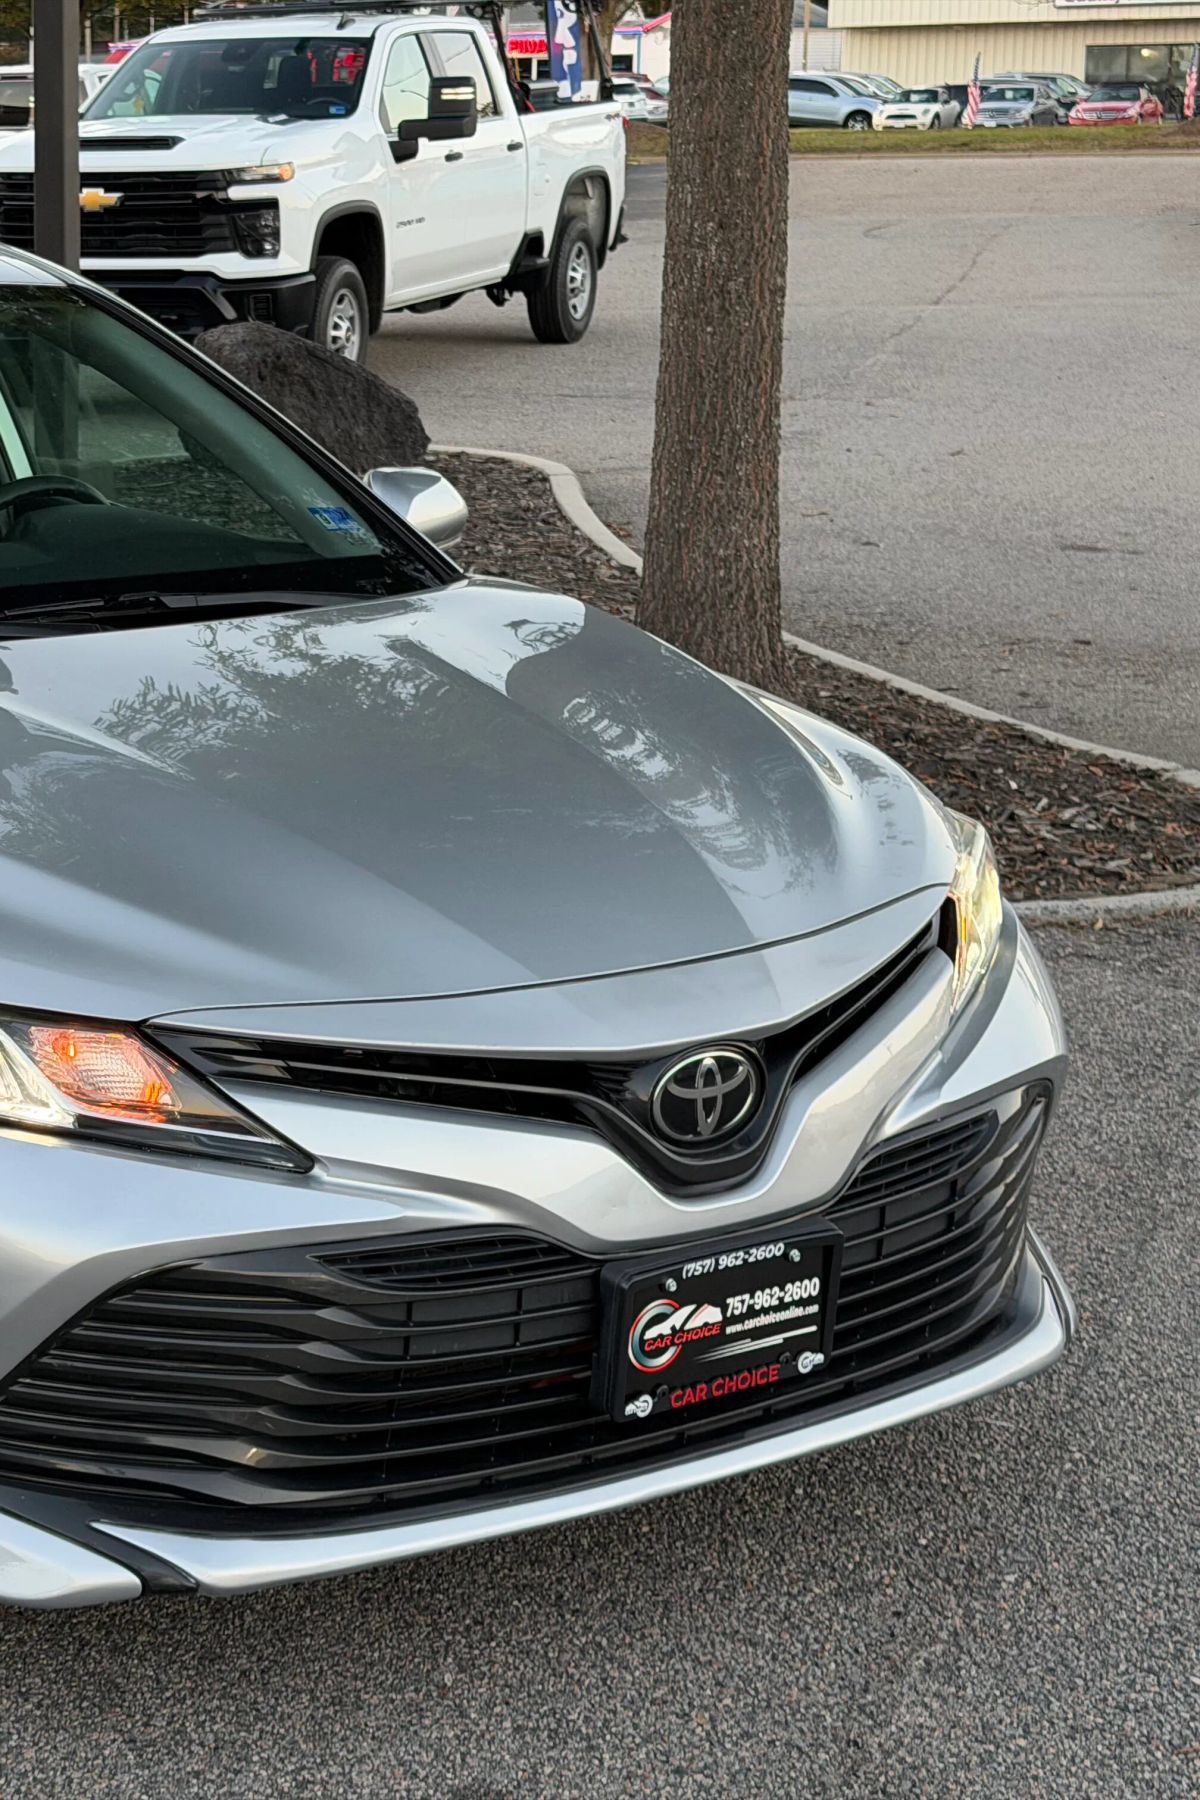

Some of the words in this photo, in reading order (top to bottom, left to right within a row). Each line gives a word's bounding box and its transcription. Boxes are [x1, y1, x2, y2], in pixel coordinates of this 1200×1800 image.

[682, 1258, 714, 1279] (757)
[718, 1243, 785, 1269] 962-2600
[726, 1277, 820, 1317] 757-962-2600
[644, 1336, 672, 1352] CAR
[674, 1323, 722, 1344] CHOICE
[725, 1304, 819, 1335] www.carchoiceonline.com
[671, 1383, 708, 1408] CAR
[711, 1364, 781, 1397] CHOICE
